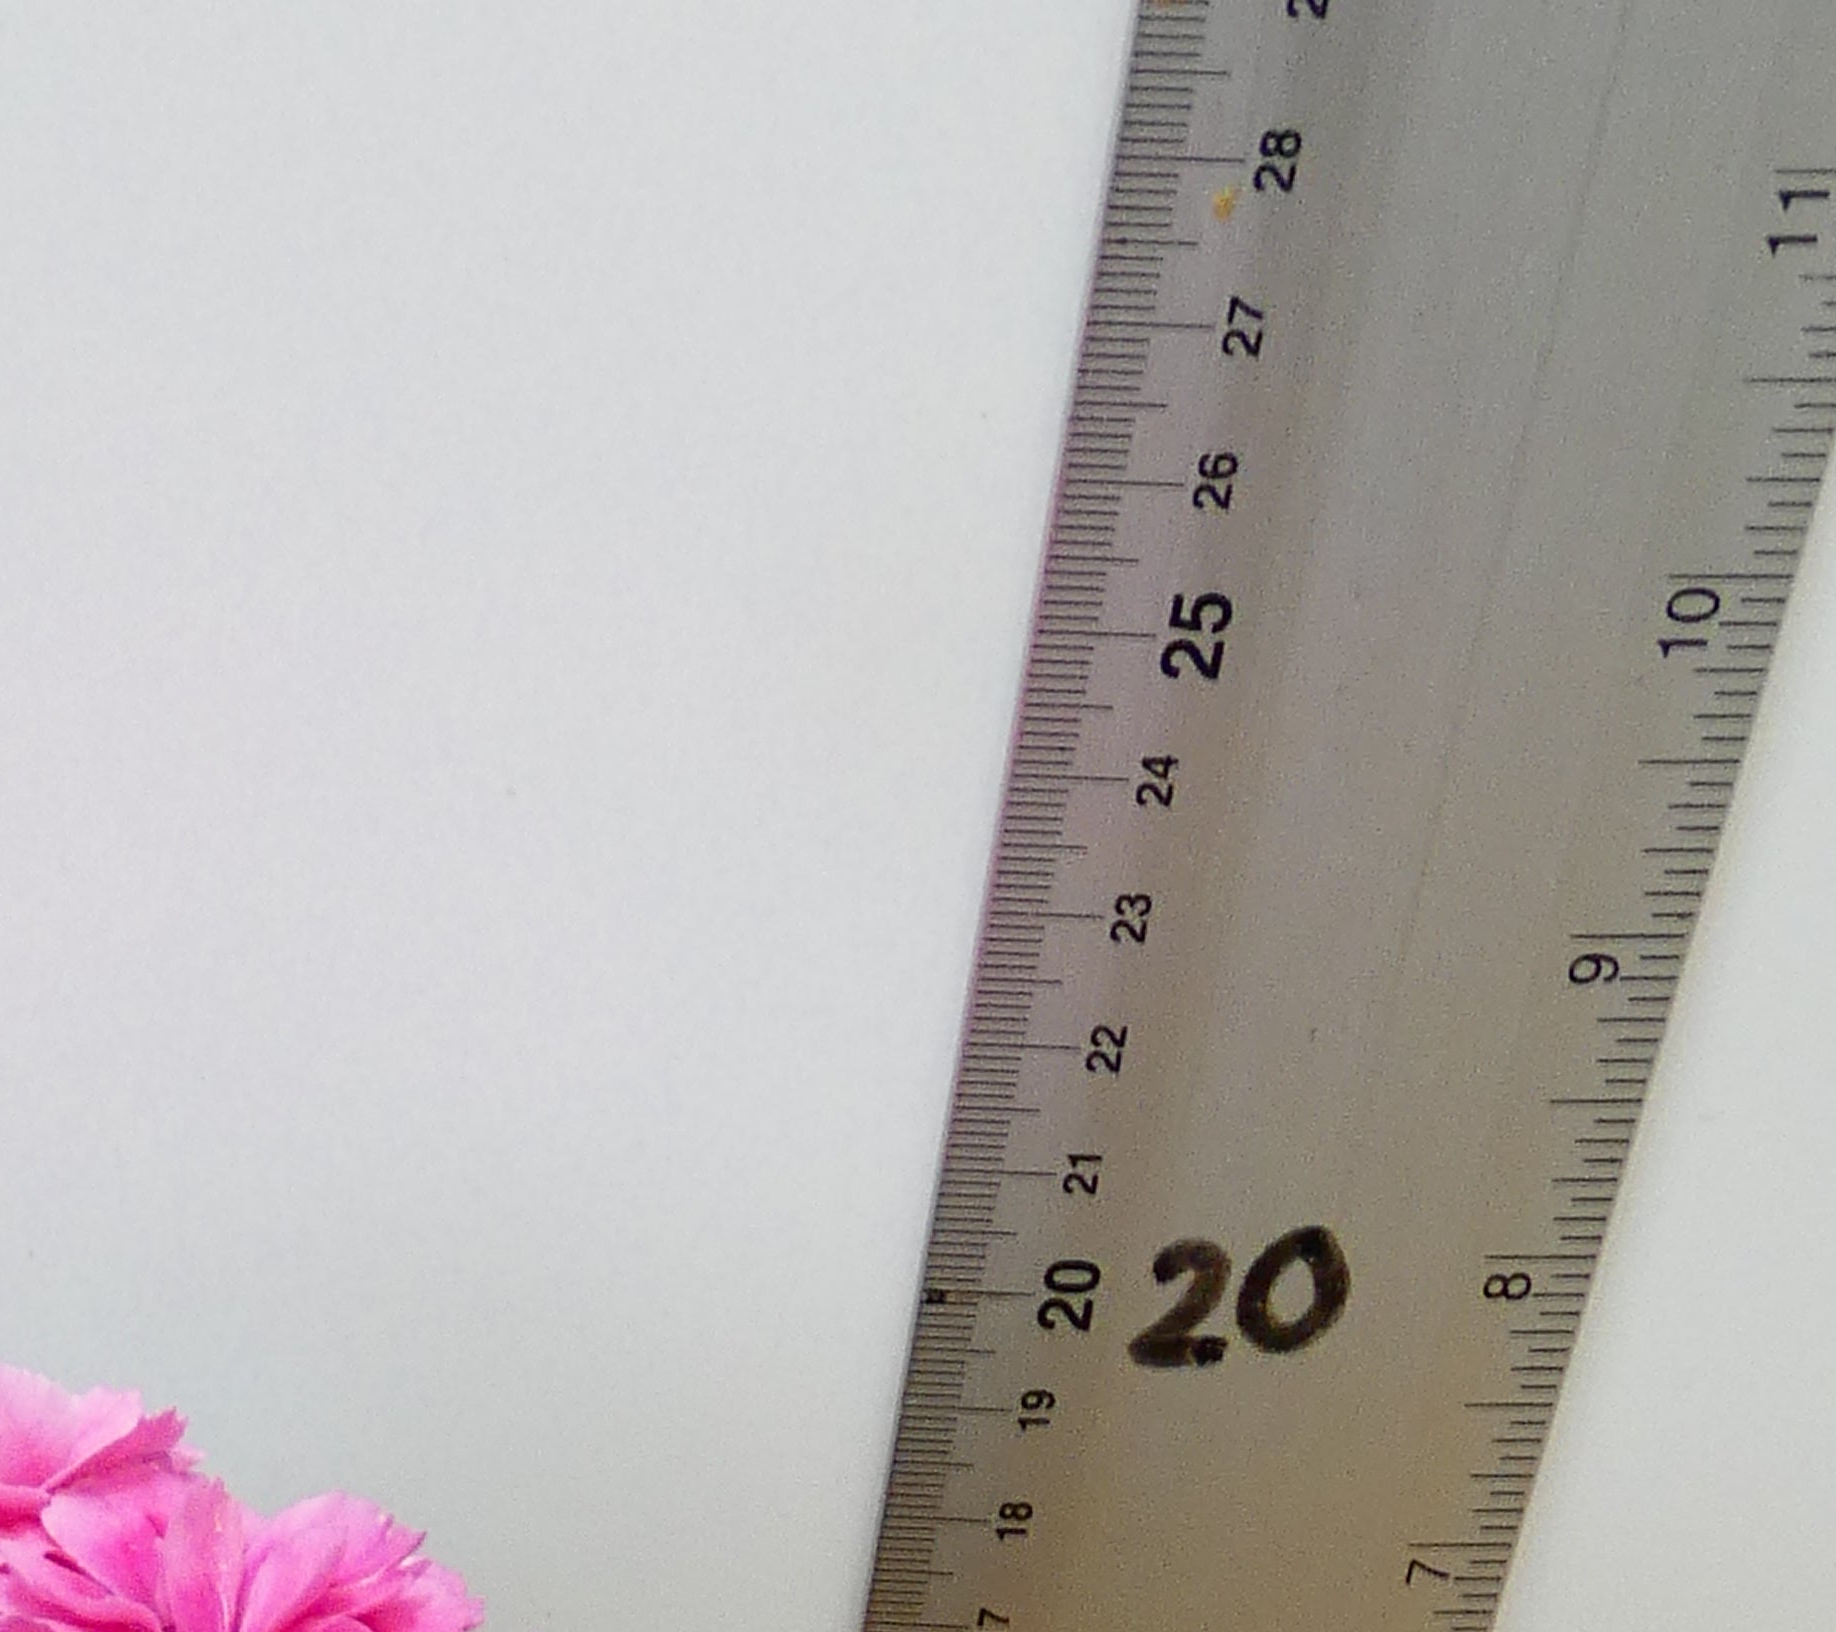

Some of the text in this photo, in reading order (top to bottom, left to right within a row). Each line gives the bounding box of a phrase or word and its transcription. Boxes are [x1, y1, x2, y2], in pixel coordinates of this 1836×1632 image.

[1252, 128, 1303, 193] 28
[1766, 189, 1831, 256] 11
[1221, 296, 1264, 359] 27
[1192, 452, 1240, 511] 26
[1159, 592, 1233, 681] 25
[1657, 587, 1721, 659] 10
[1135, 754, 1179, 808] 24
[1109, 893, 1153, 945] 23
[1568, 952, 1620, 986] 9
[1085, 1025, 1128, 1075] 22
[1062, 1153, 1103, 1196] 21
[1036, 1259, 1101, 1333] 20
[1128, 1226, 1350, 1368] 20
[1482, 1272, 1532, 1302] 8
[1017, 1389, 1056, 1432] 19
[994, 1501, 1034, 1542] 18
[1404, 1558, 1450, 1586] 7
